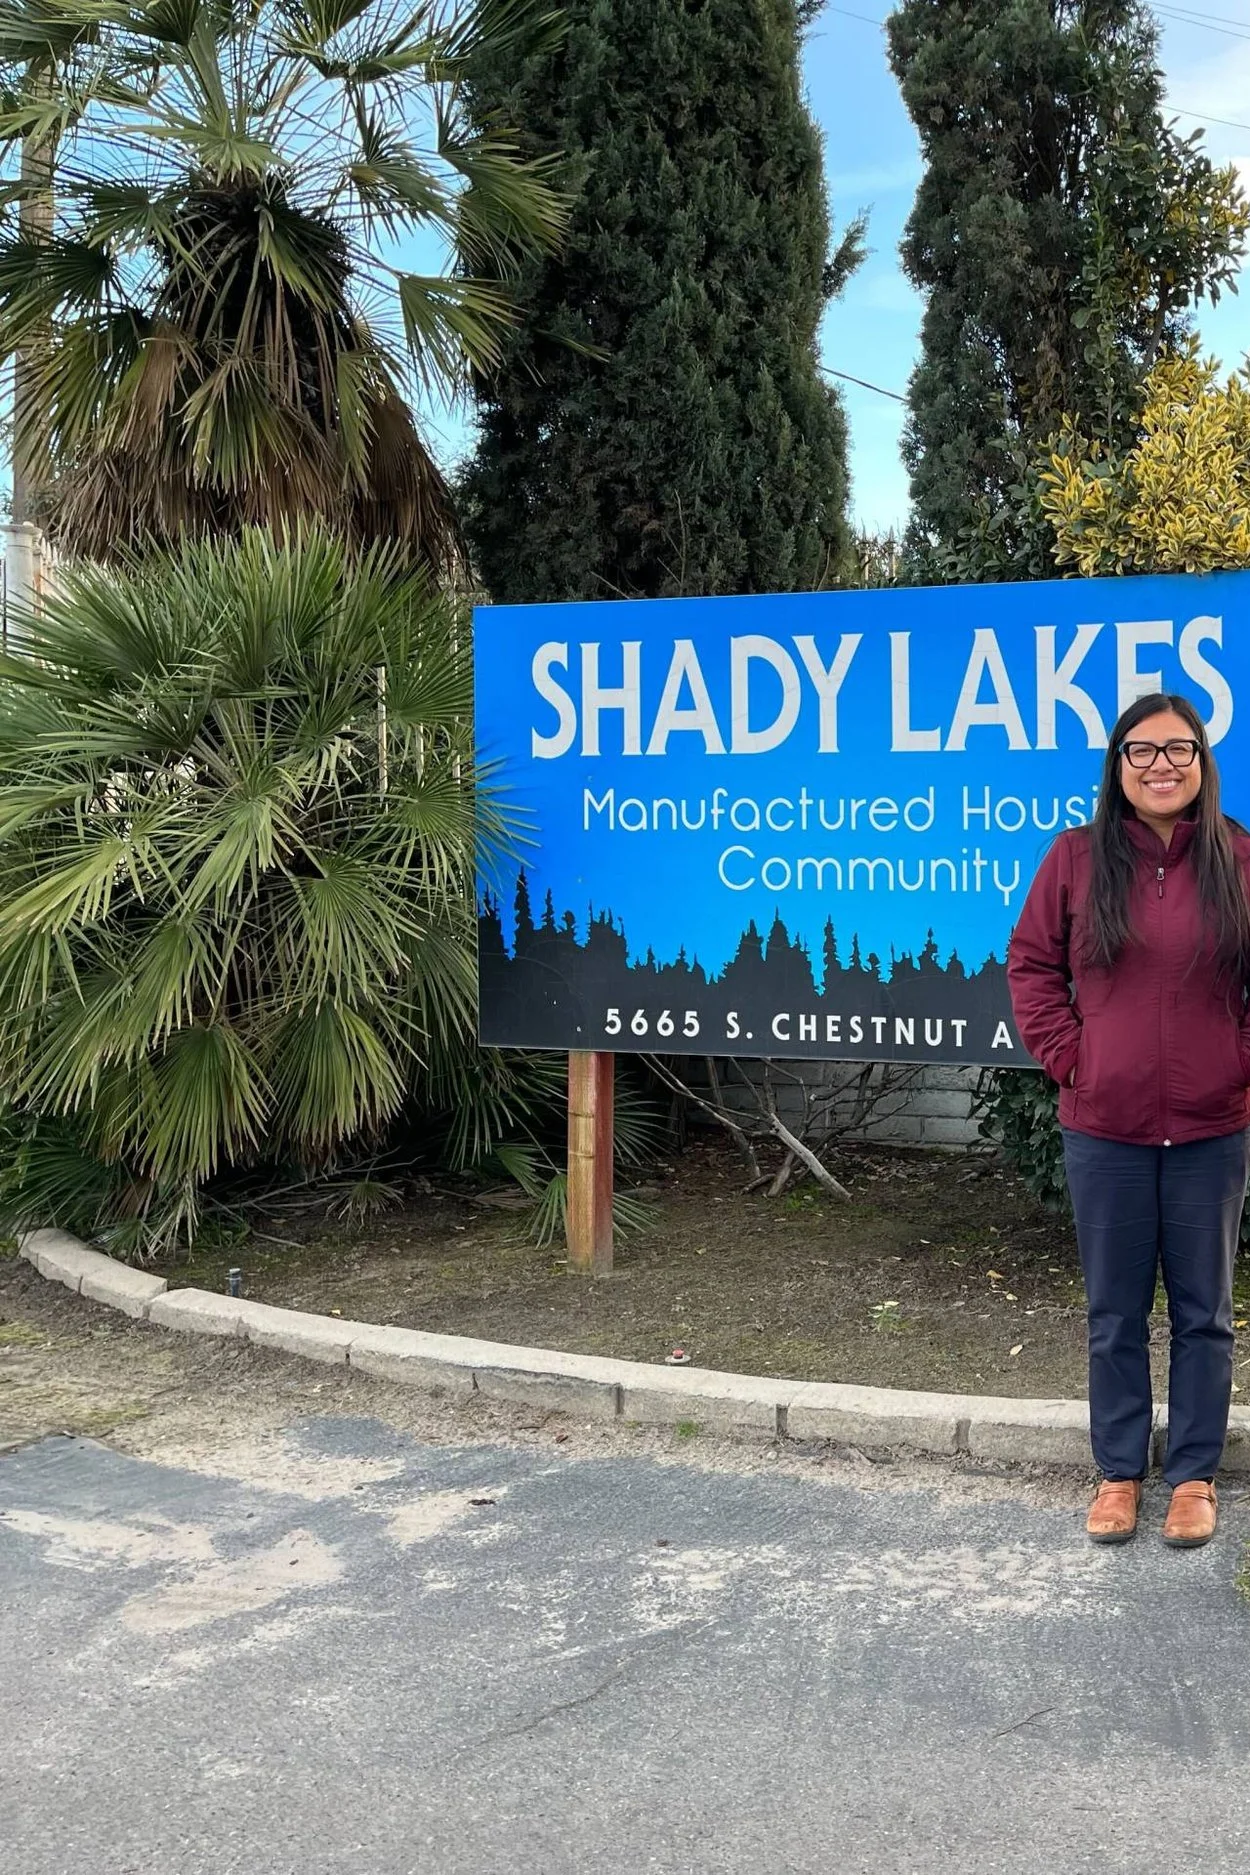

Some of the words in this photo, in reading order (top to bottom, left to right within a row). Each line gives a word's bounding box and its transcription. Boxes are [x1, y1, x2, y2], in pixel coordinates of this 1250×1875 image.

[531, 633, 864, 759] SHADY
[888, 615, 1234, 752] LAKES
[583, 786, 935, 832] Manufactured
[963, 785, 1099, 832] Housi
[718, 845, 1020, 906] Community
[604, 1008, 700, 1037] 5665
[726, 1011, 753, 1040] S.
[771, 1013, 967, 1047] CHESTNUT
[991, 1021, 1014, 1049] A
